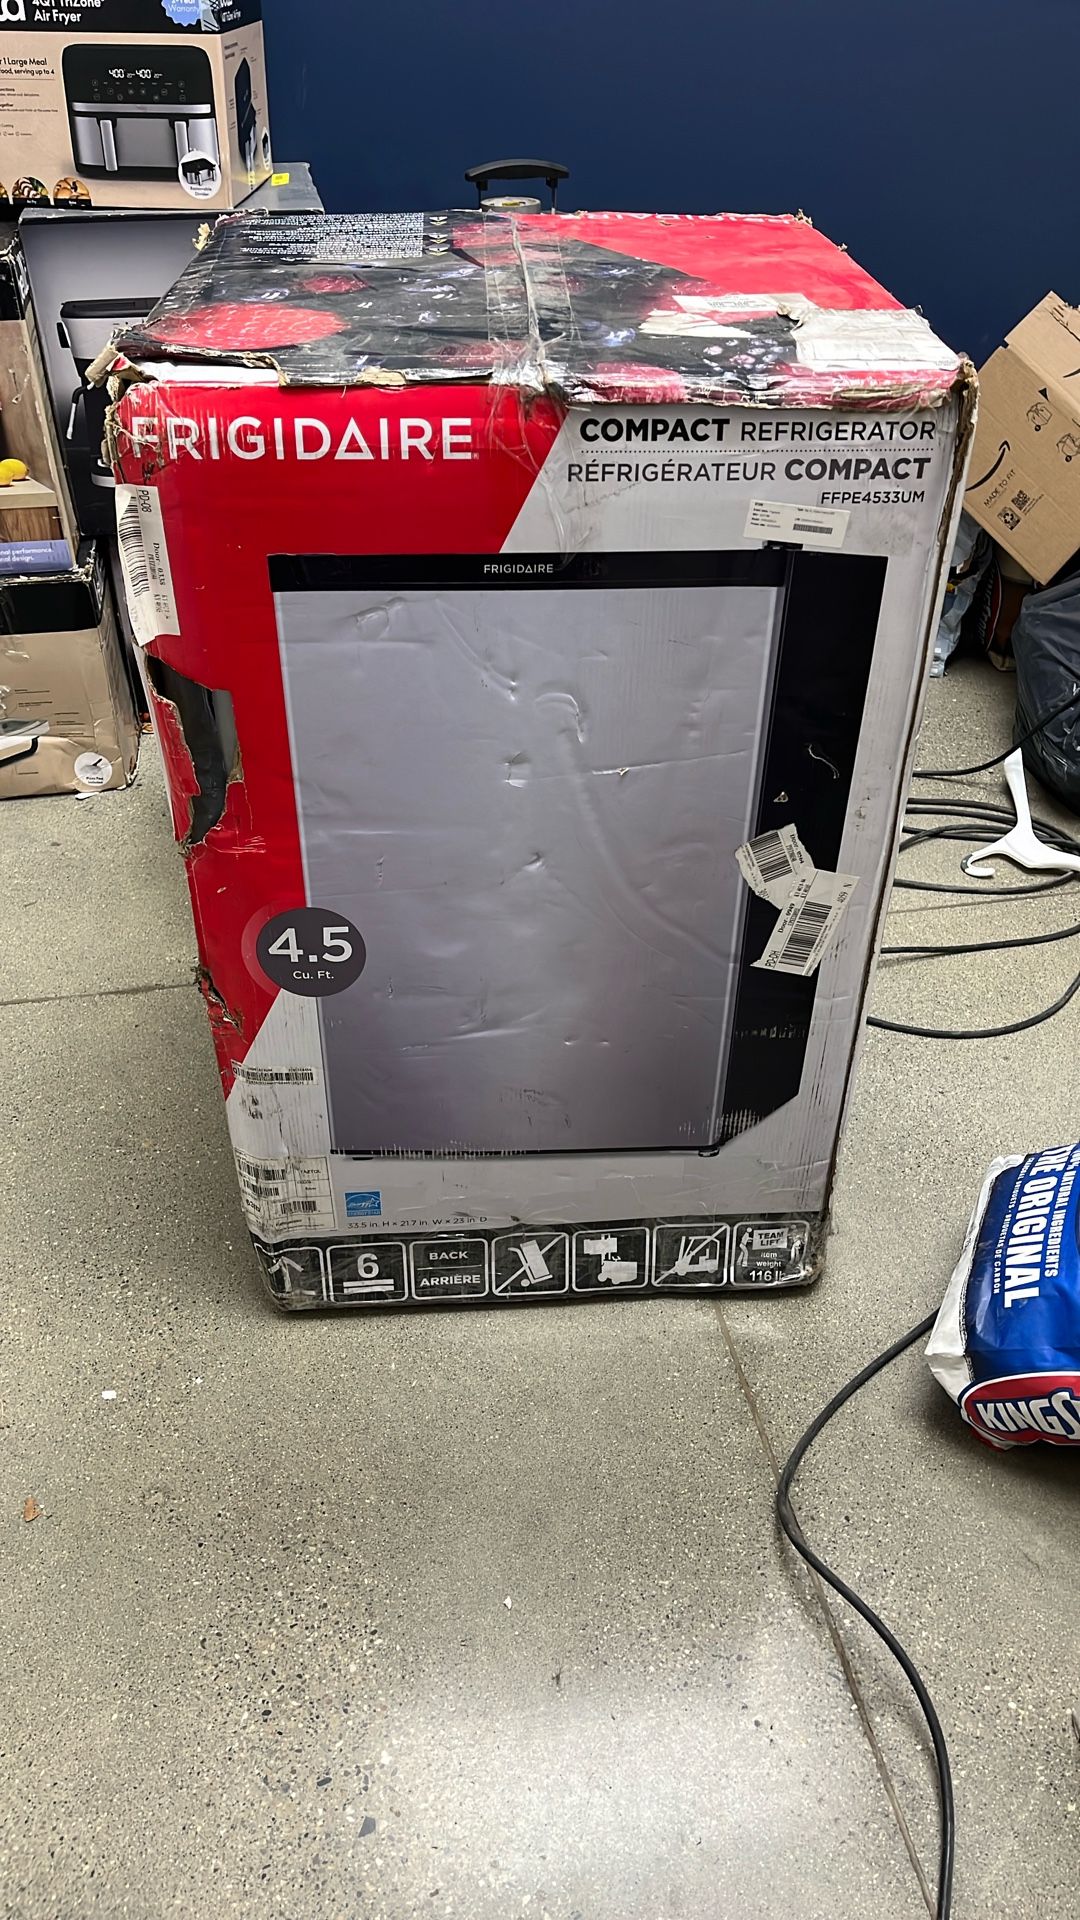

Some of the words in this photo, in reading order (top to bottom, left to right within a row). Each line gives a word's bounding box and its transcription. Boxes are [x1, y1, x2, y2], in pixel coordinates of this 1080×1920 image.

[34, 9, 50, 21] Air
[52, 9, 82, 26] Fryer
[7, 57, 27, 67] Large
[14, 68, 34, 76] serving
[131, 416, 472, 460] FRIGIDAIRE
[580, 418, 730, 442] COMPACT
[741, 421, 936, 442] REFRIGERATOR
[567, 459, 776, 482] RÉFRIGÉRATEUR
[784, 458, 932, 480] COMPACT
[820, 490, 925, 504] FFPE4533UM
[484, 564, 554, 574] FRIGIDAIRE
[268, 926, 352, 962] 4.5
[293, 970, 313, 979] Cu.
[318, 970, 334, 979] Ft.
[1029, 1144, 1076, 1176] THE
[1008, 1180, 1022, 1209] BRIQUETS
[1054, 1170, 1076, 1208] NATURAL
[758, 1231, 784, 1240] TEAM
[998, 1213, 1012, 1247] BRIQUETAS
[1004, 1176, 1058, 1308] ORIGINAL
[994, 1248, 1002, 1258] DE
[1044, 1209, 1067, 1278] INGREDIENTS
[357, 1254, 379, 1278] 6
[429, 1251, 468, 1261] BACK
[420, 1273, 481, 1287] ARRIÈRE
[749, 1270, 772, 1282] 116
[993, 1261, 1002, 1294] CARBÓN
[976, 1392, 1080, 1440] KINGS
